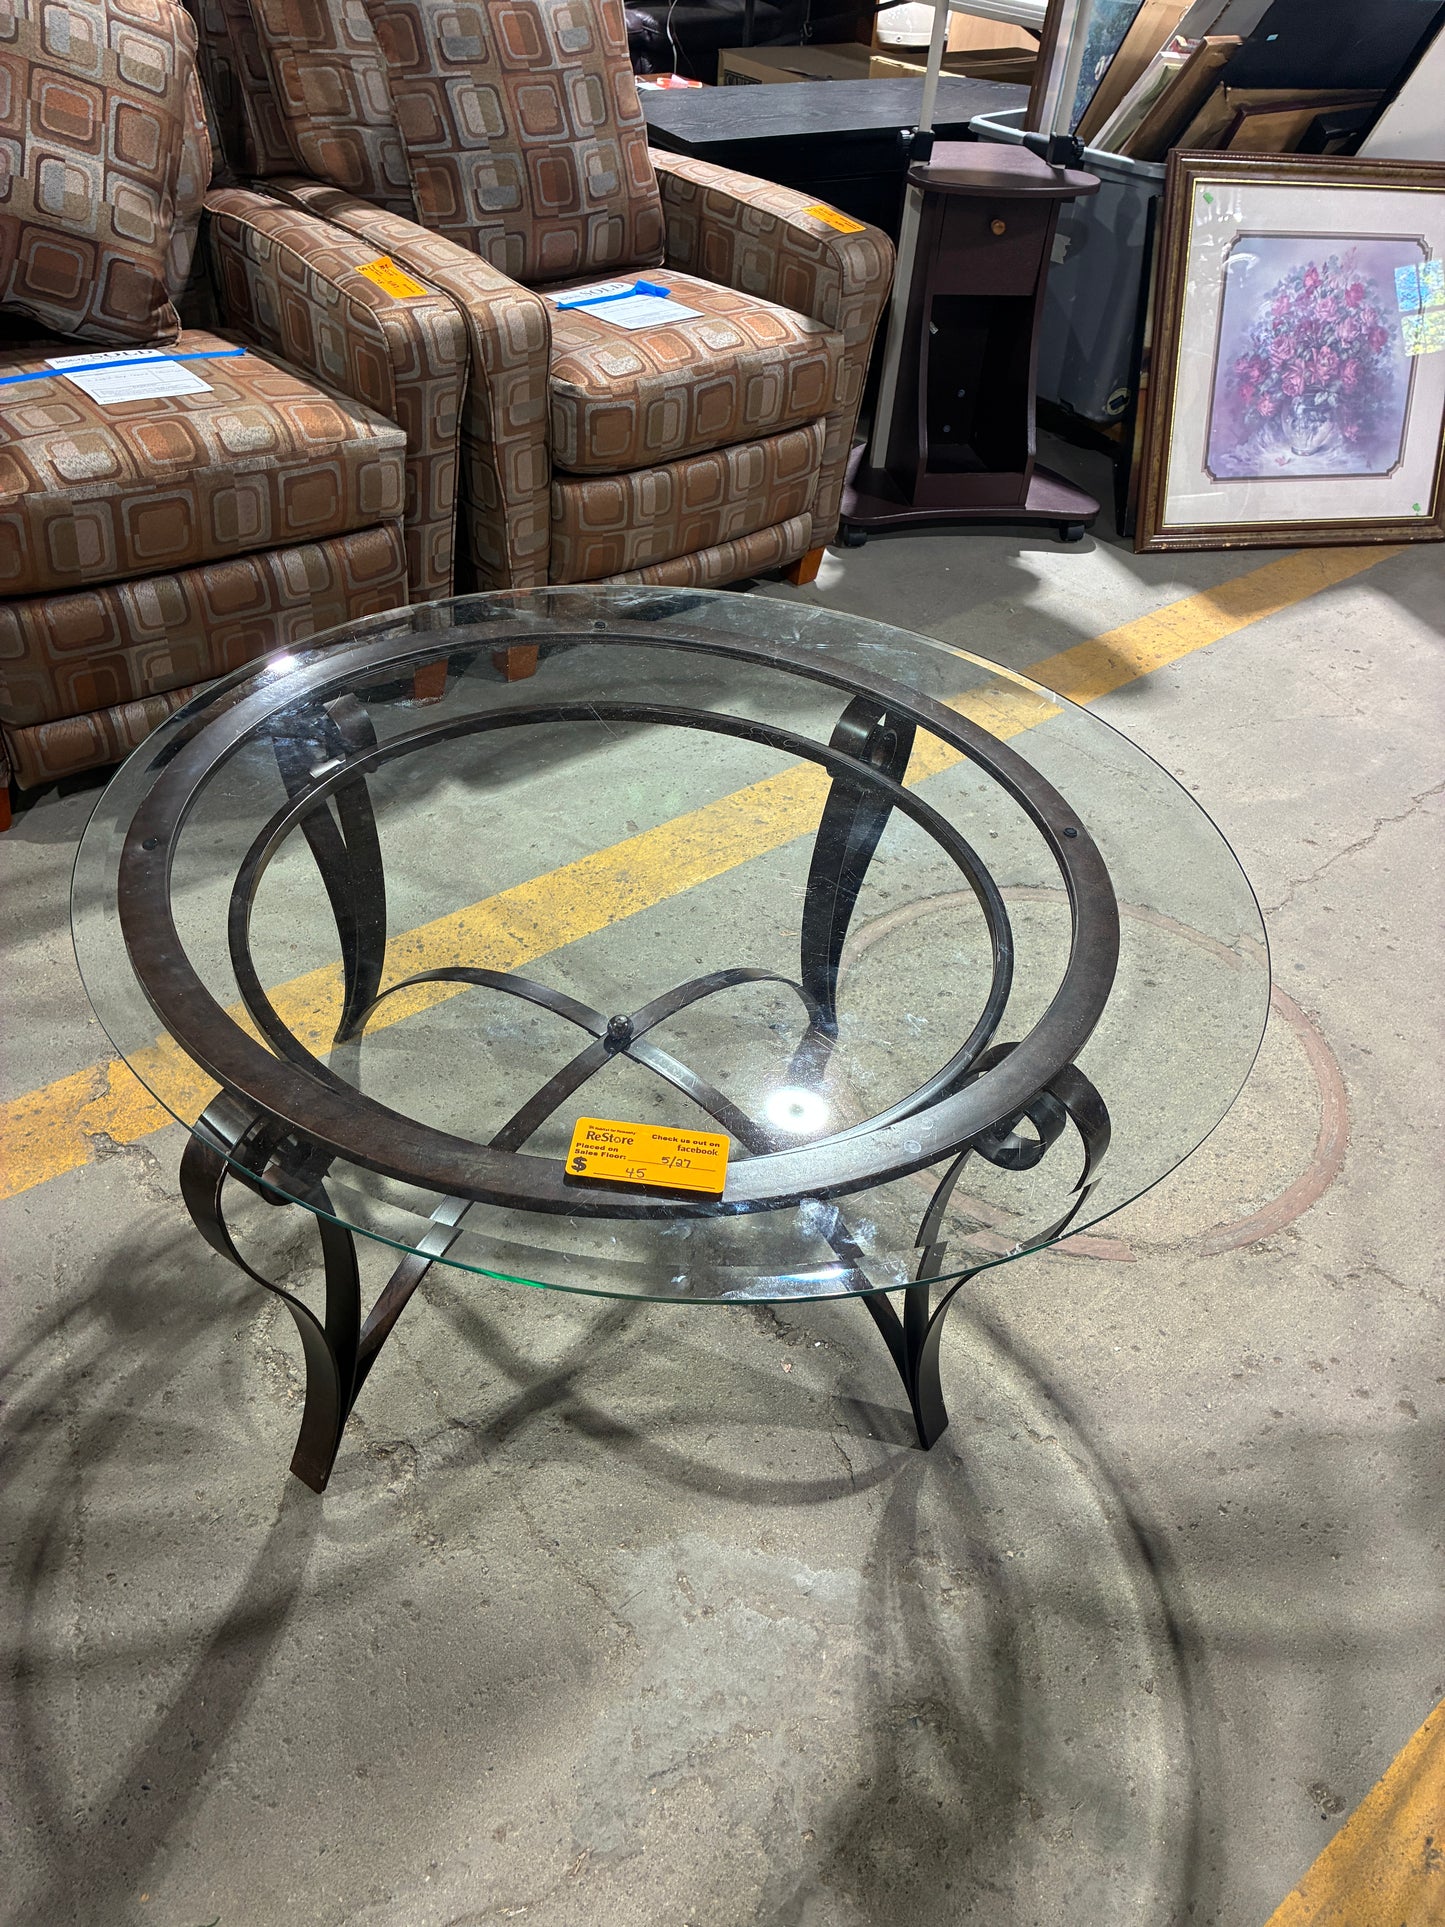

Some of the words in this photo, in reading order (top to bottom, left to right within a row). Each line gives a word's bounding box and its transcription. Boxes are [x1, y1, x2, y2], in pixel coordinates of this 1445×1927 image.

[580, 284, 624, 296] SOLD
[89, 350, 153, 359] SOLD
[586, 1130, 634, 1145] ReStore
[651, 1134, 678, 1142] Check
[575, 1142, 606, 1151] Placed
[677, 1144, 719, 1156] facebook
[574, 1148, 598, 1157] Sales
[600, 1151, 627, 1160] Floor:
[661, 1155, 692, 1169] 5/27
[571, 1156, 588, 1172] $
[625, 1167, 648, 1179] 45
